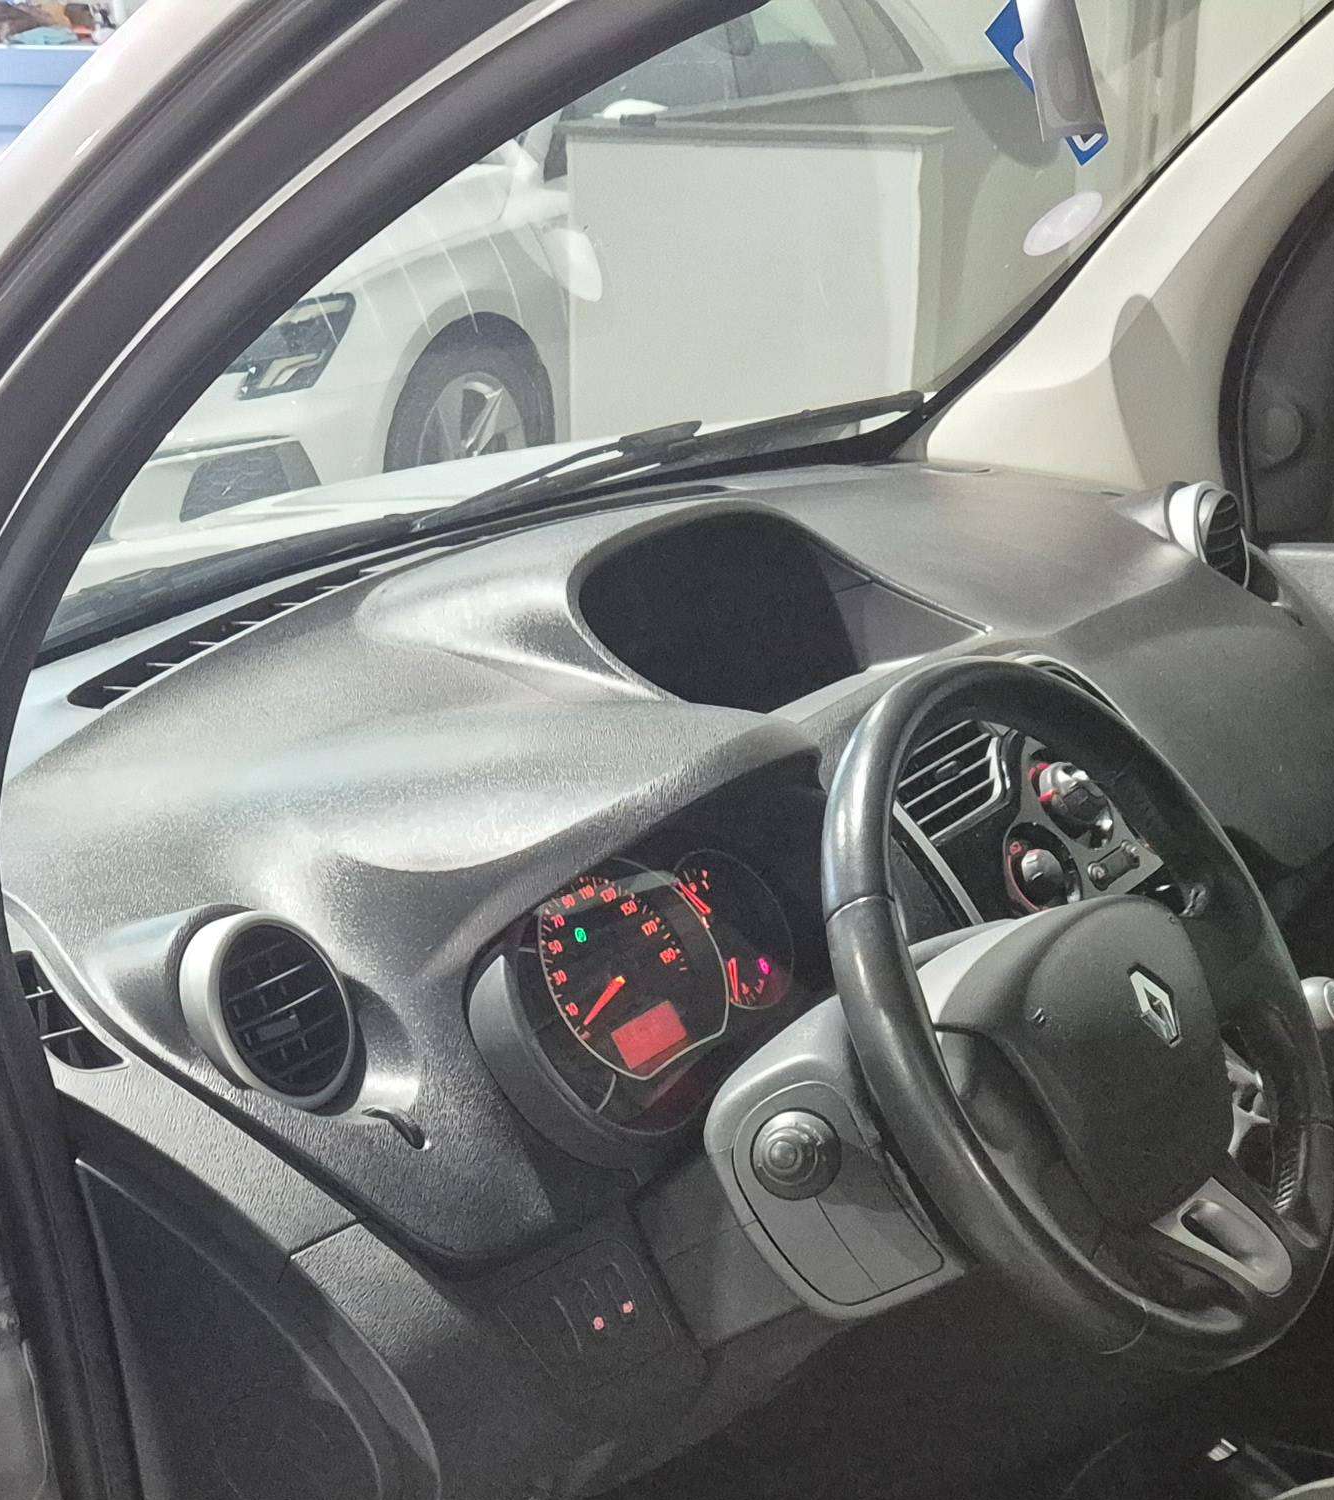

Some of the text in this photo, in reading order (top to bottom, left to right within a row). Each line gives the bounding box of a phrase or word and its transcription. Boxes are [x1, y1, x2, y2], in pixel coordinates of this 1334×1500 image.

[561, 894, 576, 908] 90
[620, 900, 638, 916] 150
[551, 914, 566, 929] 70
[641, 920, 658, 936] 170
[547, 939, 563, 955] 50
[551, 969, 567, 986] 30
